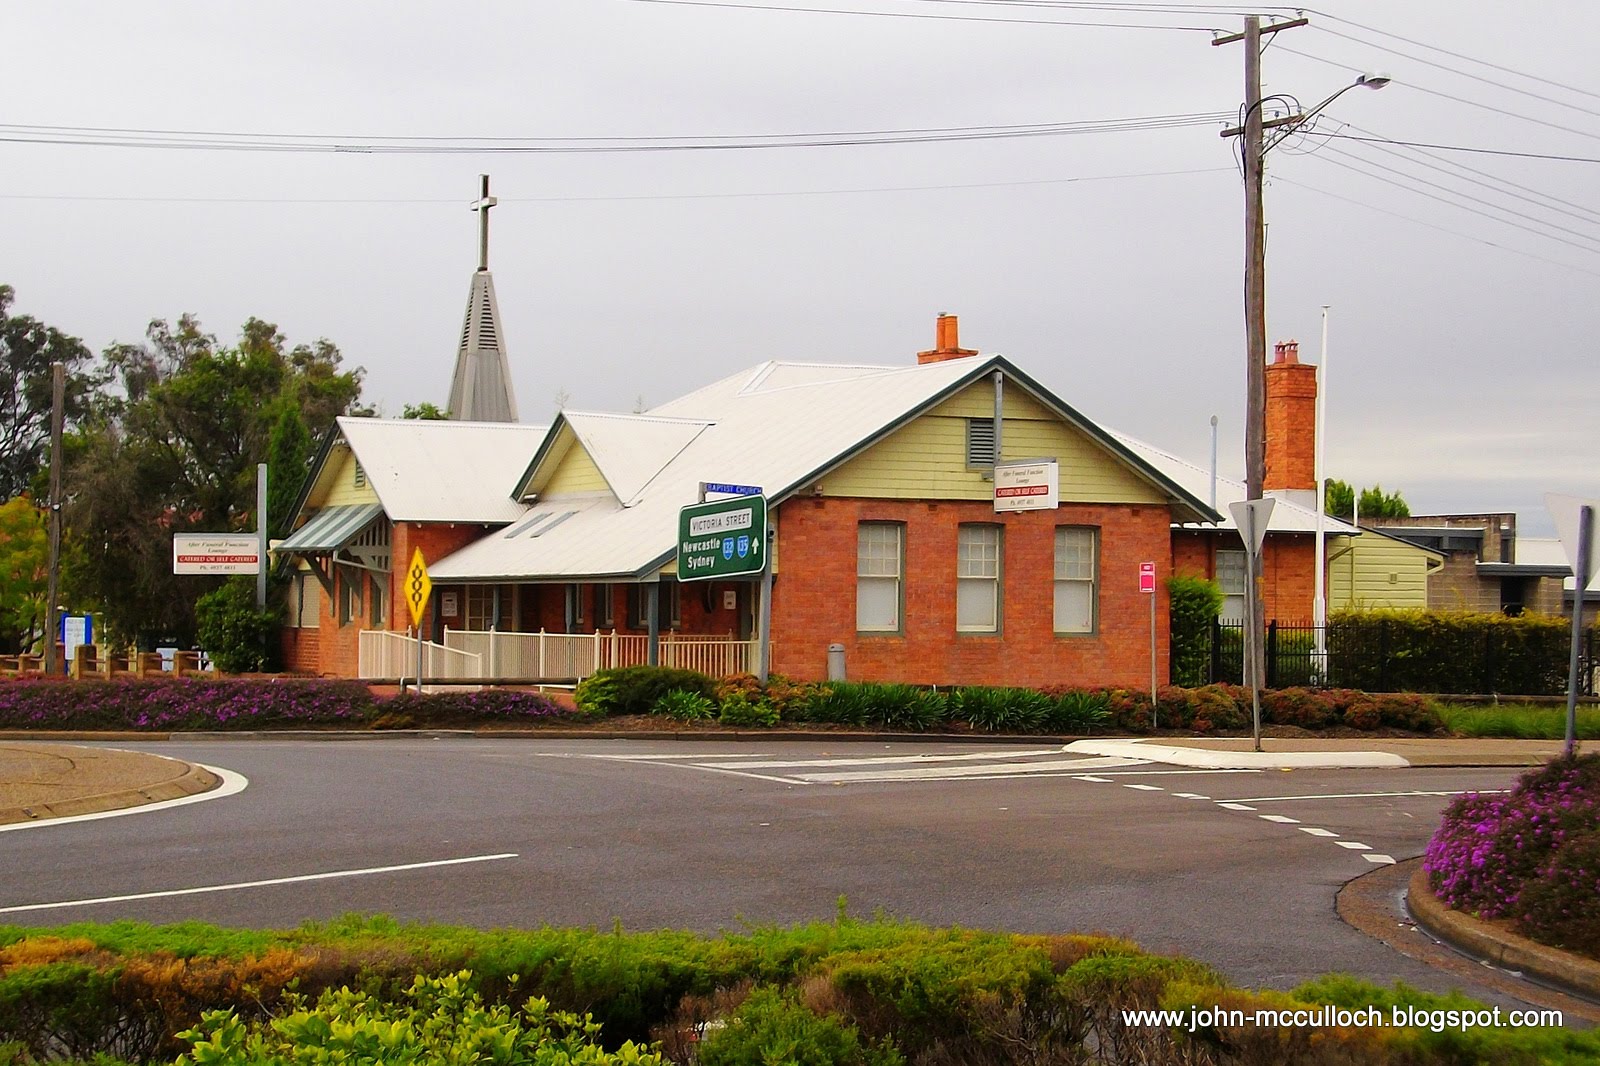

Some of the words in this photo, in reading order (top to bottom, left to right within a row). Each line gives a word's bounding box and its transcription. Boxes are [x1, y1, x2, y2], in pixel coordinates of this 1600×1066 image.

[707, 483, 734, 493] BAPTIST
[736, 485, 763, 495] CHURCH
[692, 518, 722, 532] VICTORIA
[725, 513, 750, 526] STREET
[682, 537, 720, 554] Newcastle
[687, 556, 715, 571] Sydney
